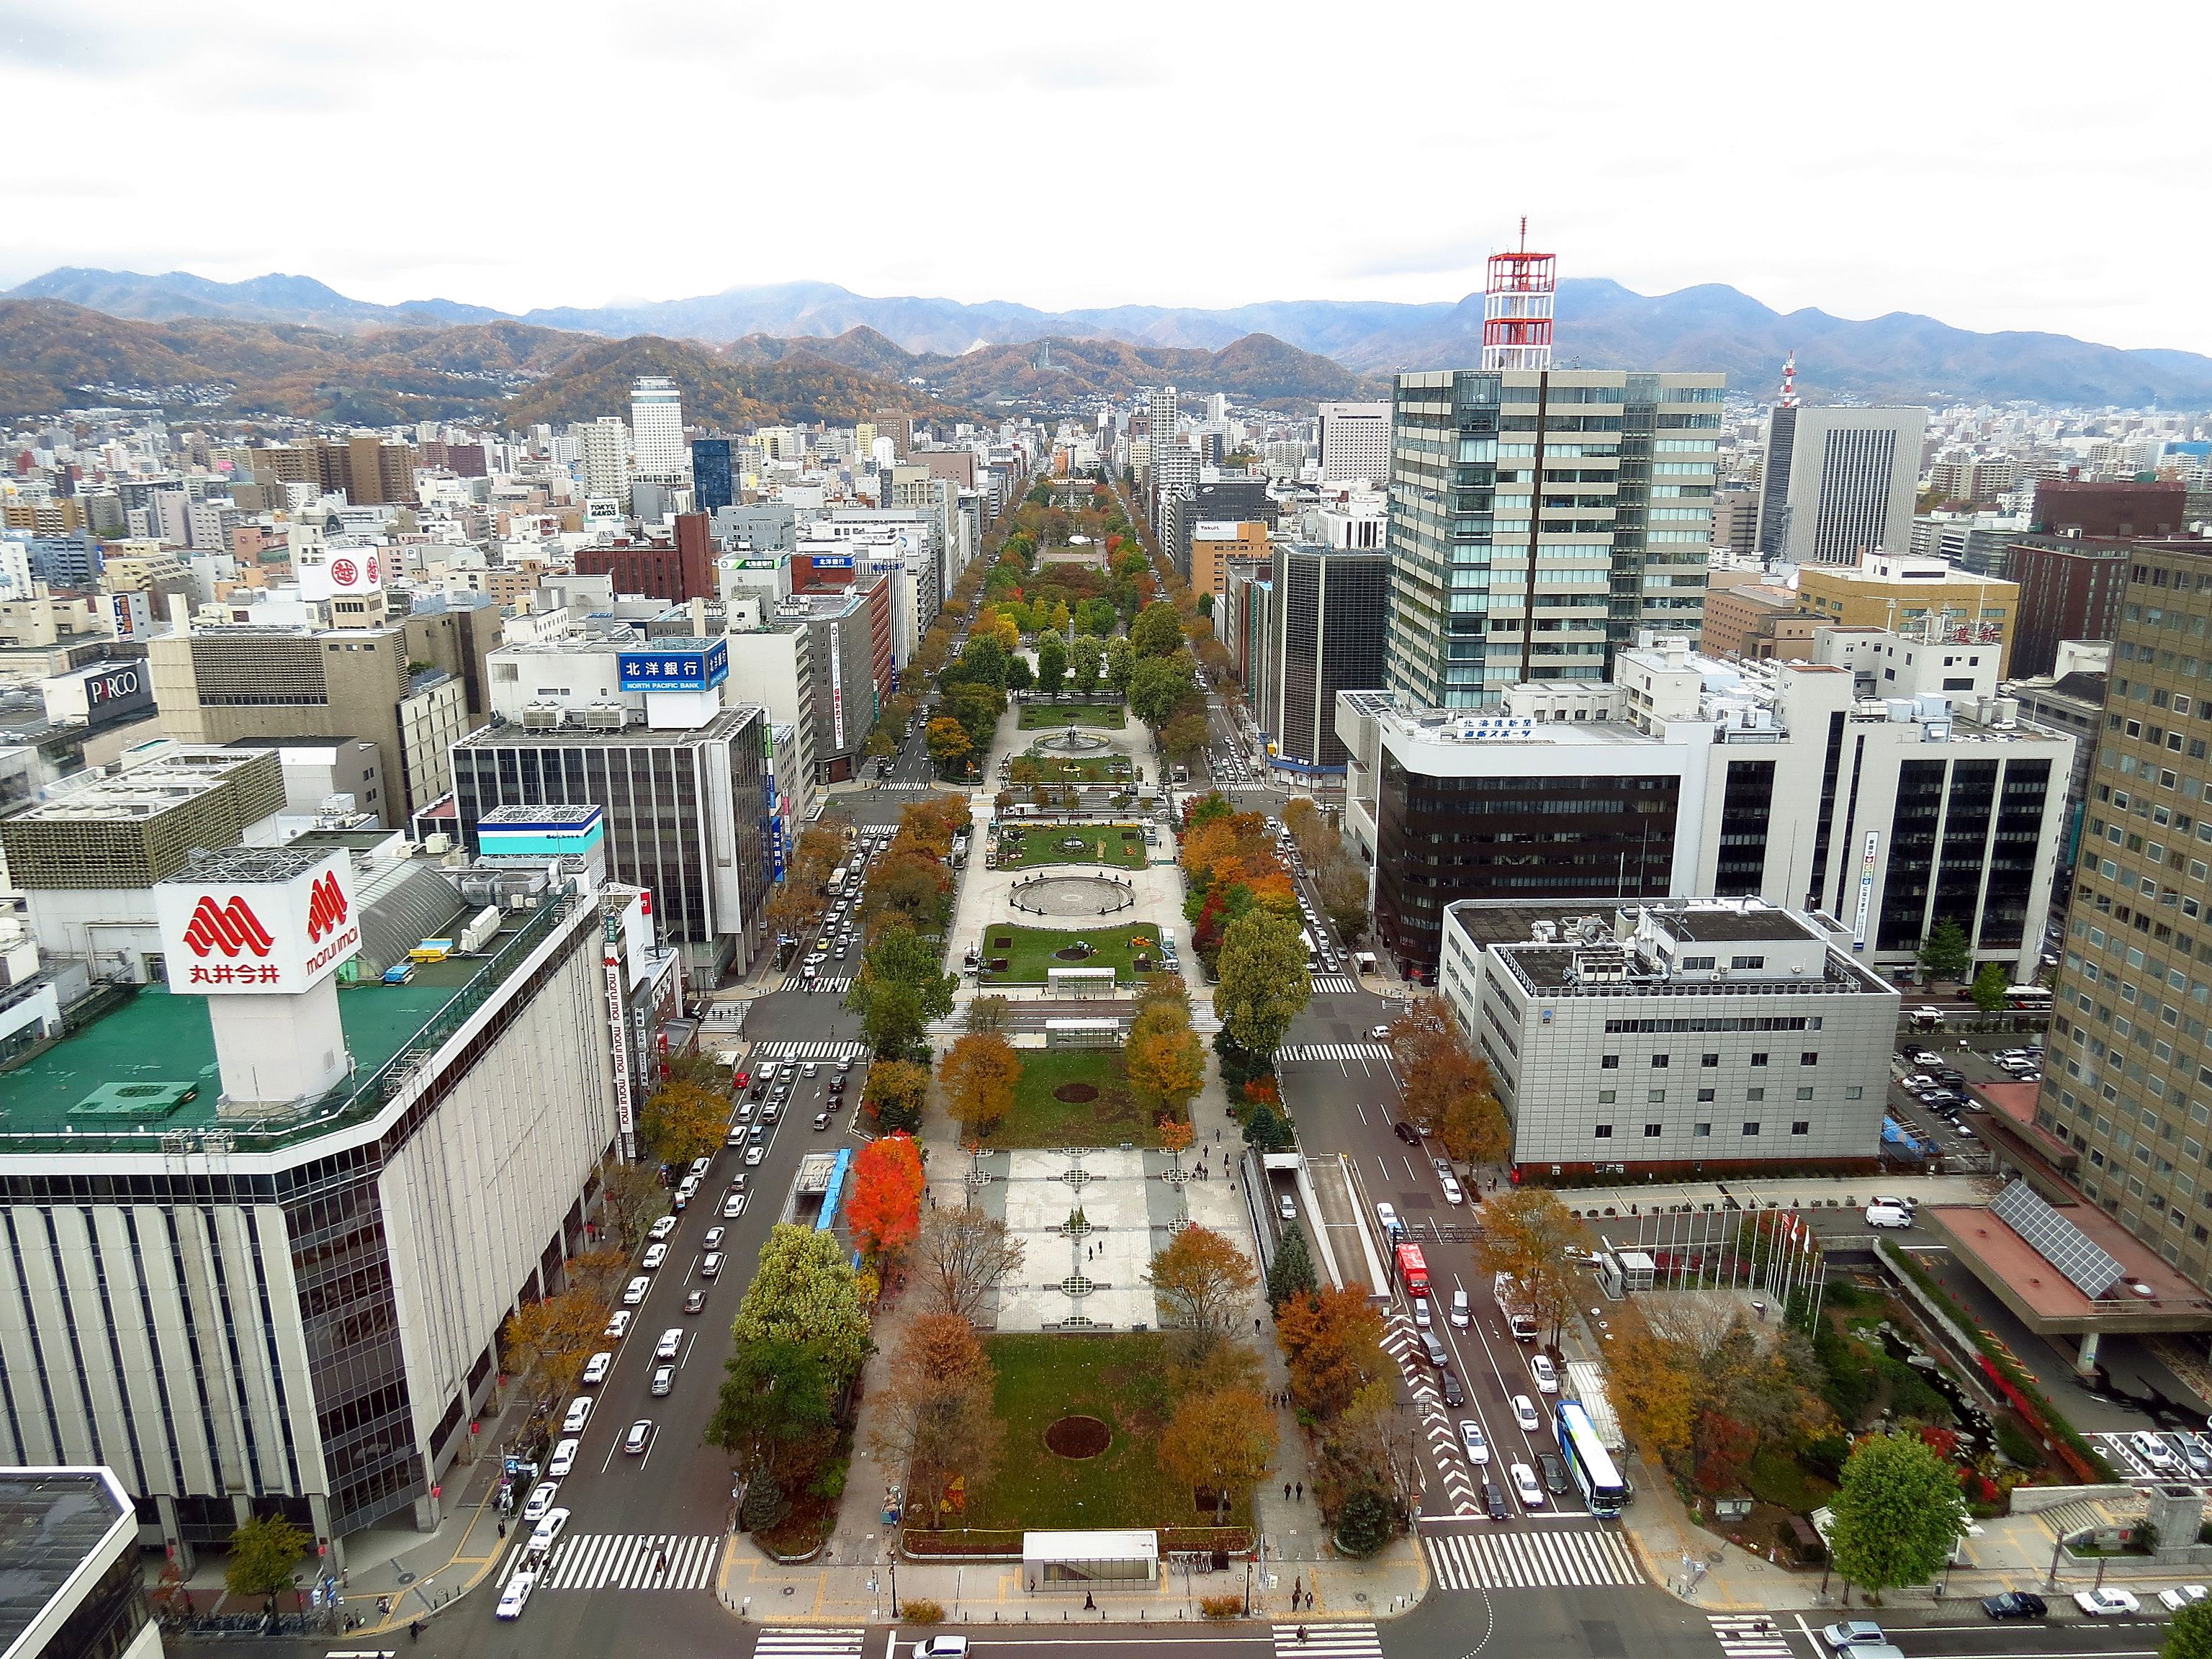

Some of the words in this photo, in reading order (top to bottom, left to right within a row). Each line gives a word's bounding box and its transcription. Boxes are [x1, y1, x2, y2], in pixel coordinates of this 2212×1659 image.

[626, 661, 698, 676] 北洋銀行
[91, 671, 138, 703] PARCO
[189, 963, 280, 984] 丸井今井
